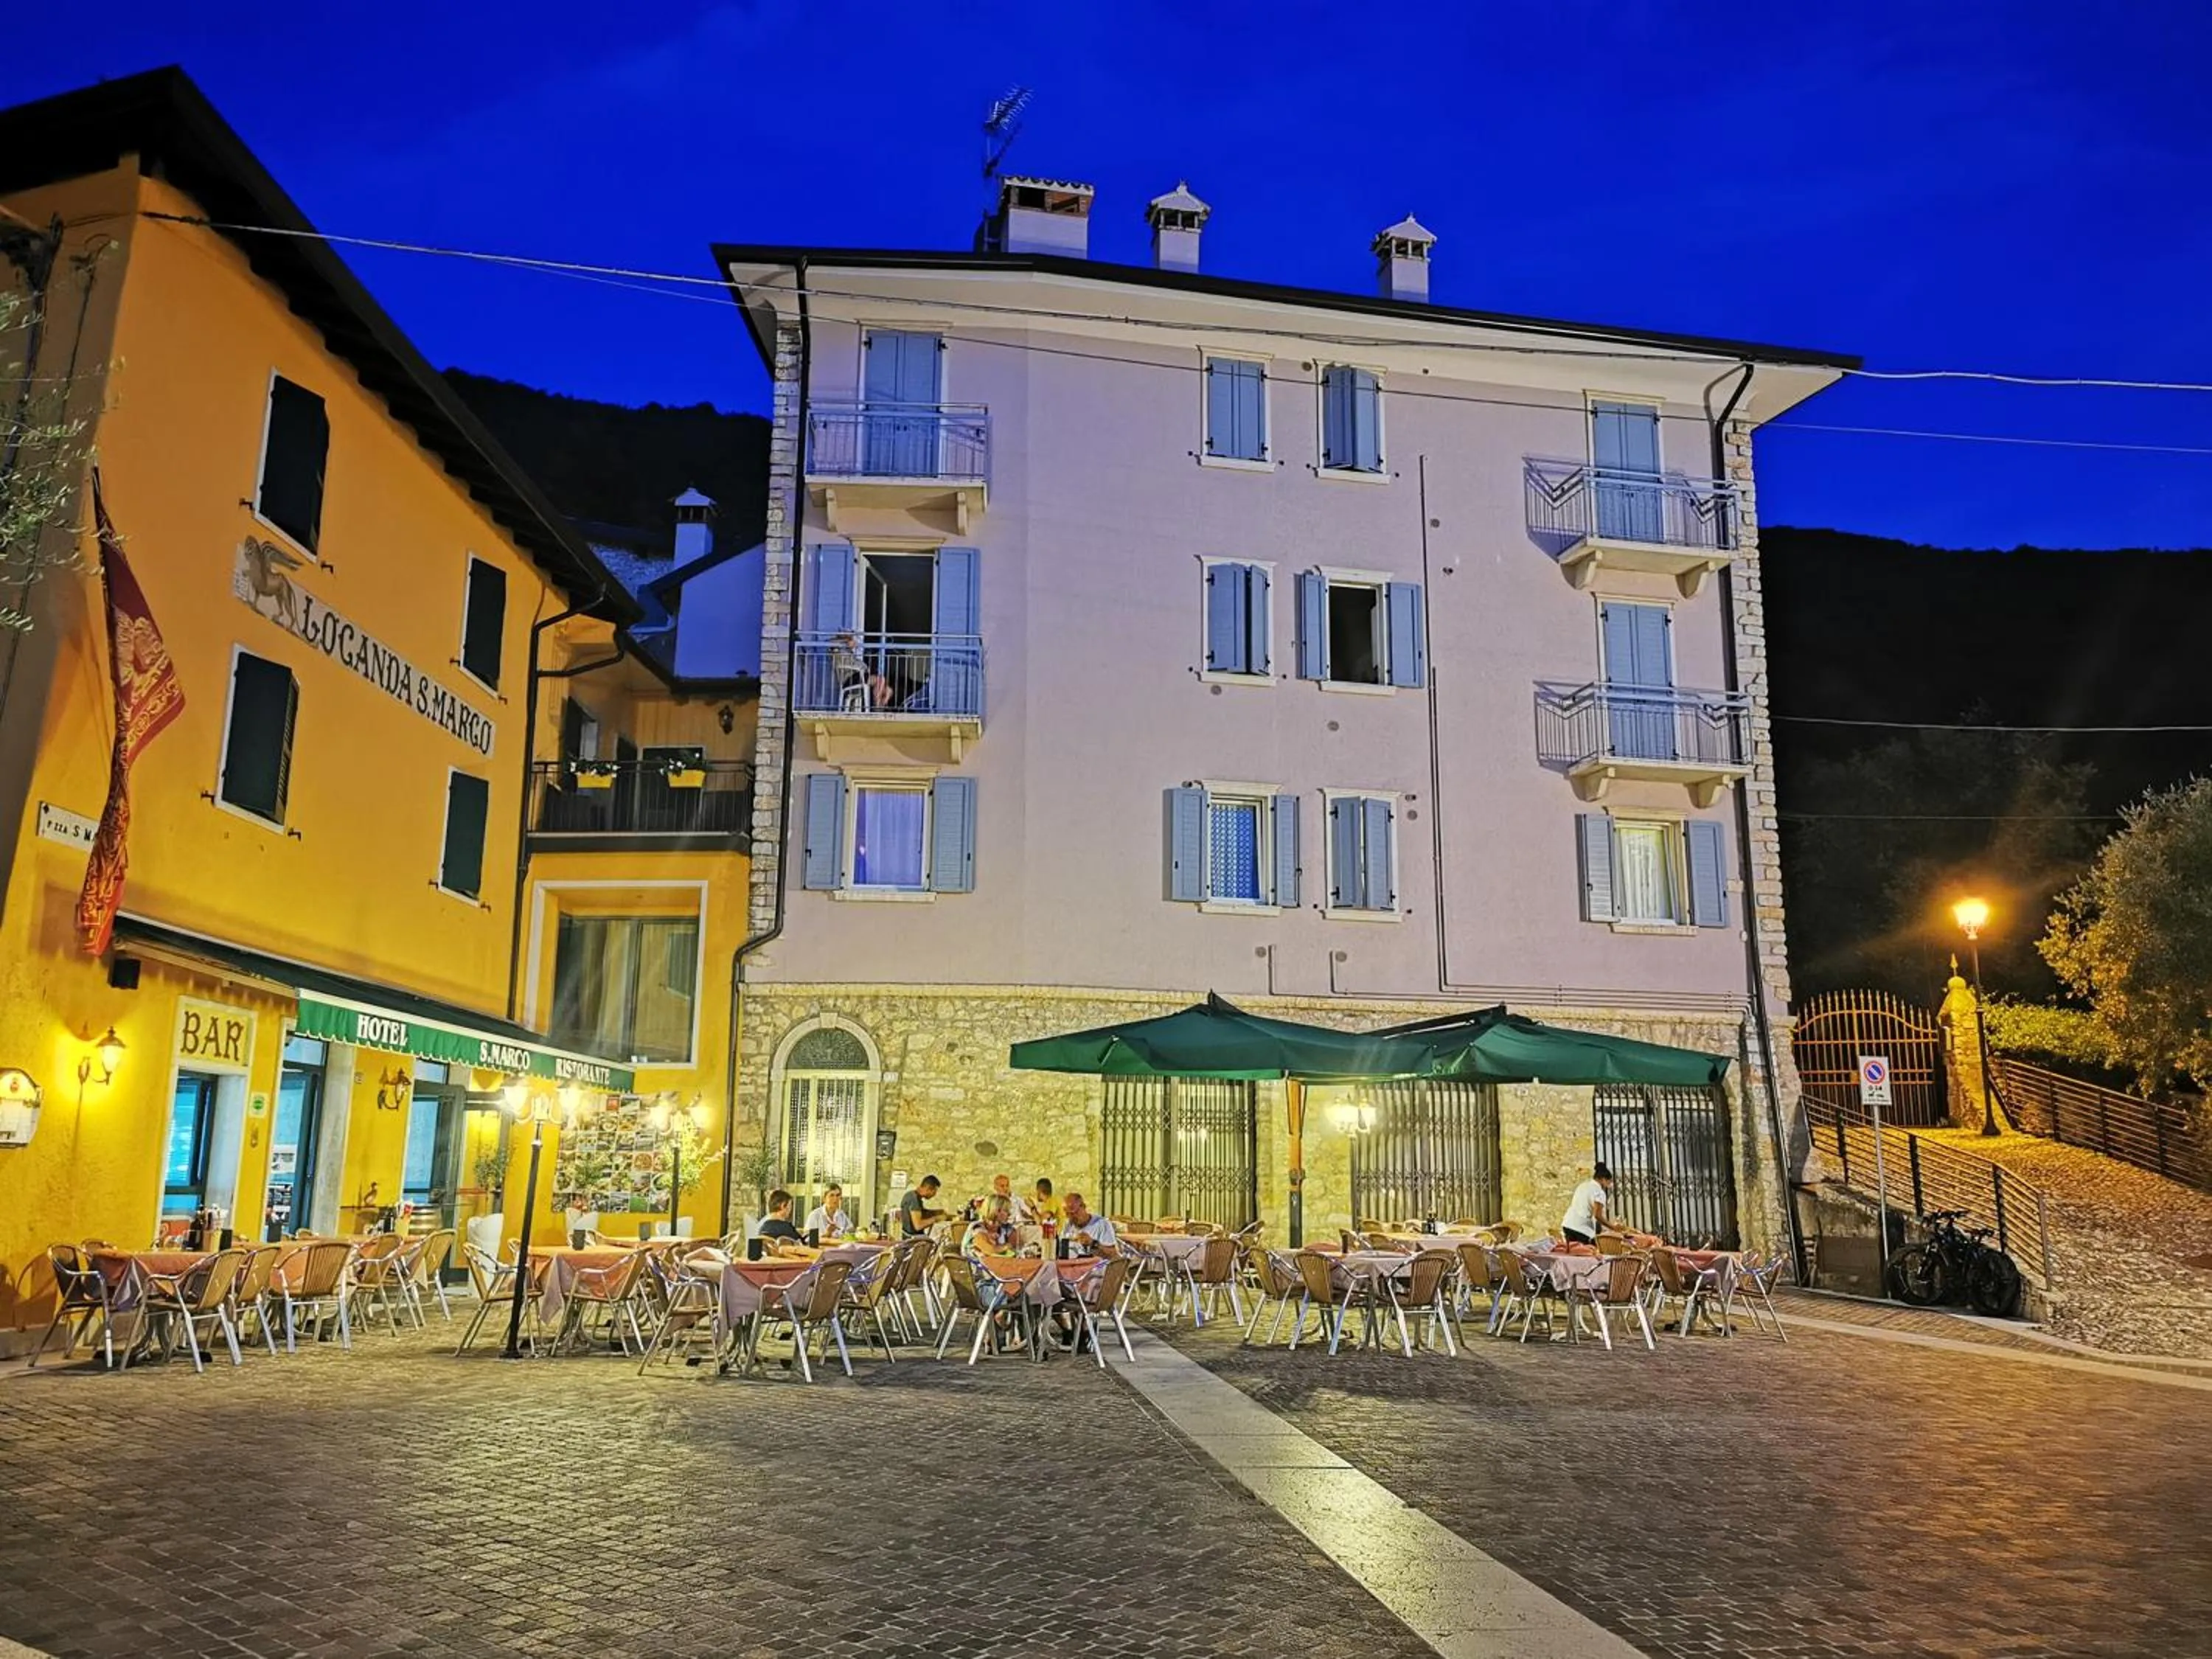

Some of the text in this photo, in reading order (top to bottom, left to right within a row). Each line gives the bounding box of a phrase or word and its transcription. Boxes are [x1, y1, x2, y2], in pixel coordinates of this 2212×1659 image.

[302, 595, 412, 706] LOCANDA
[83, 828, 95, 841] M
[180, 1011, 244, 1061] BAR
[357, 1014, 408, 1046] HOTEL
[555, 1057, 611, 1085] RISTORANTE
